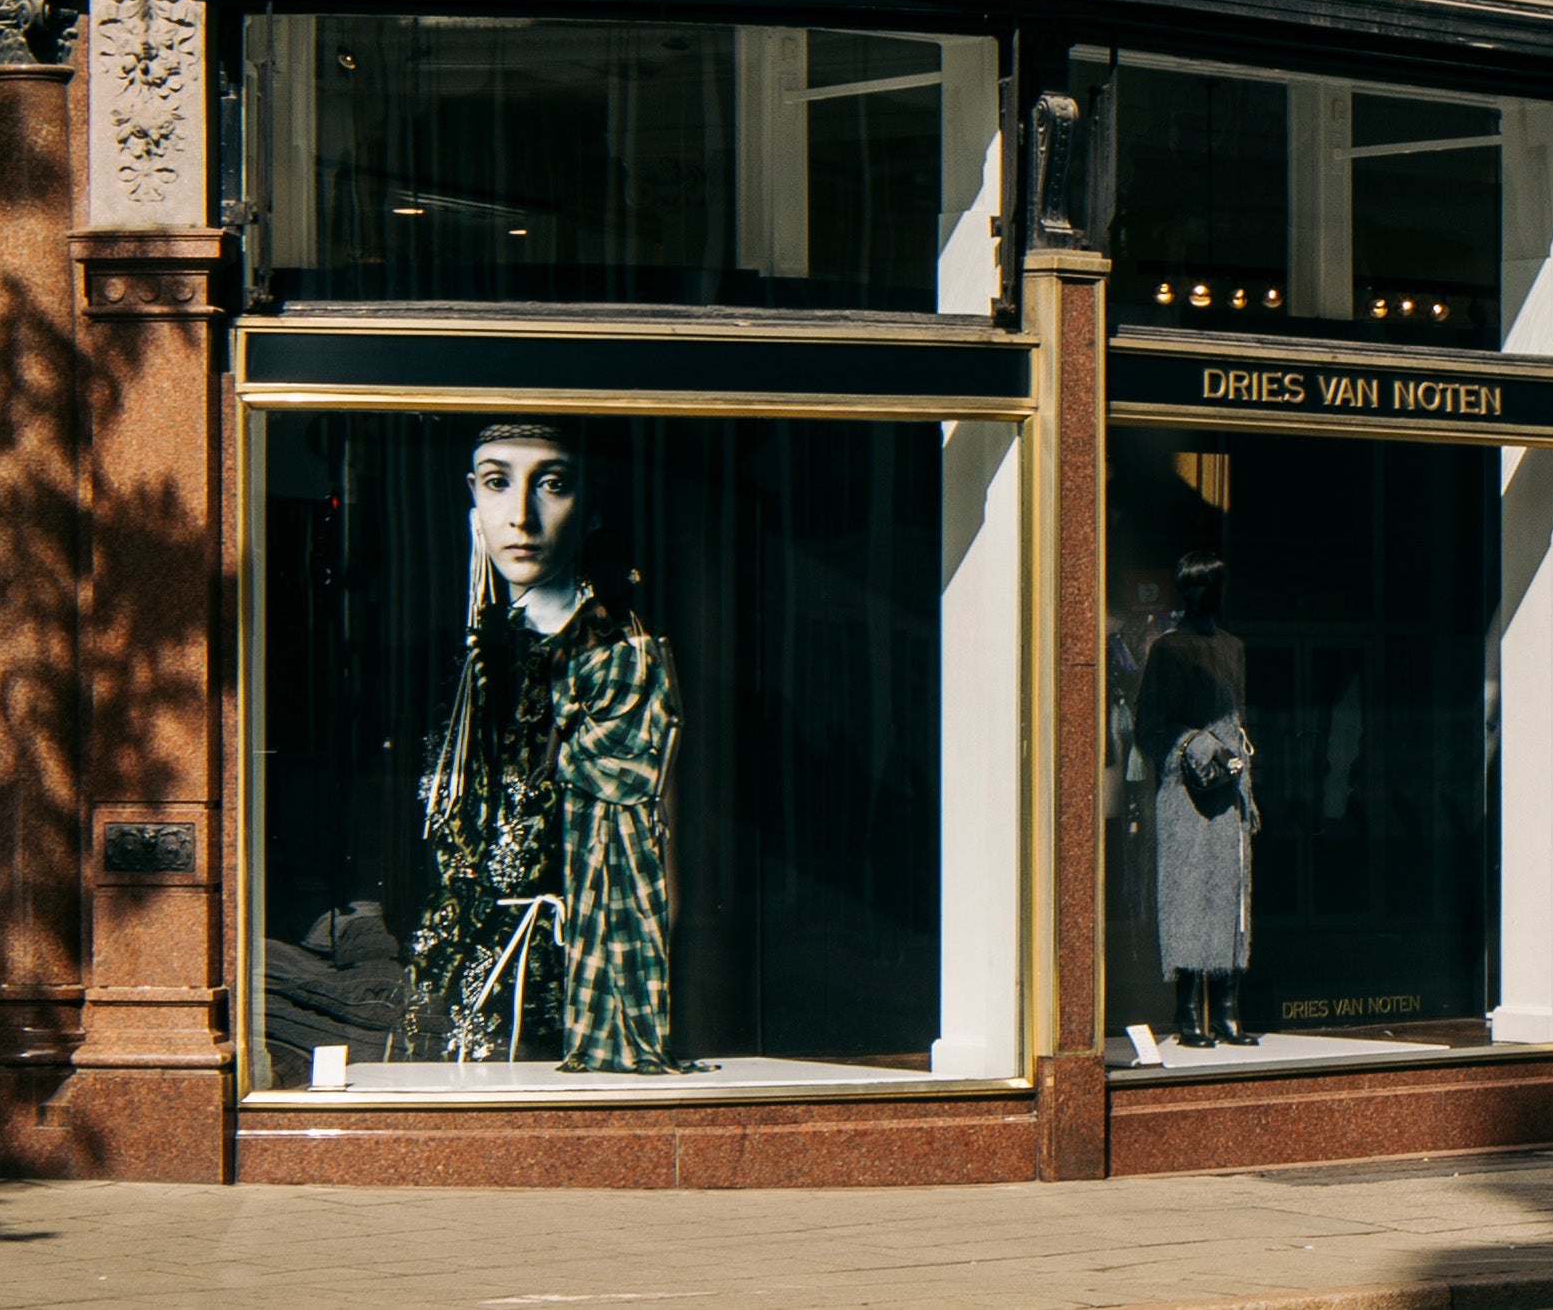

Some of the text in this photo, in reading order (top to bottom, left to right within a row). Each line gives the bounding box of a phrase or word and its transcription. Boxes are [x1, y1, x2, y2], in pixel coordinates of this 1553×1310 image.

[1202, 368, 1503, 416] DRIES VAN NOTEN
[1283, 995, 1421, 1019] DRIES VAN NOTEN
